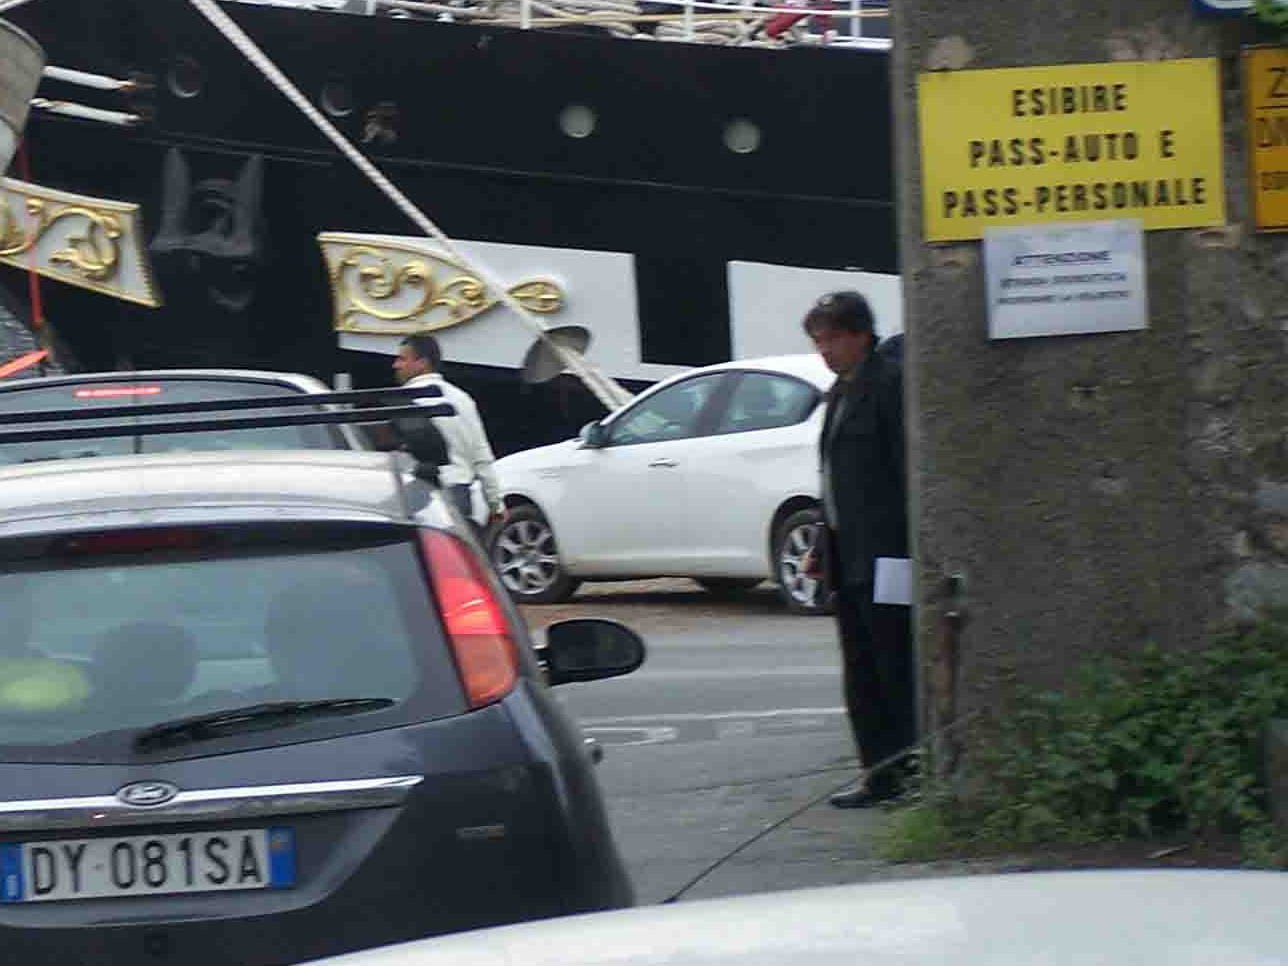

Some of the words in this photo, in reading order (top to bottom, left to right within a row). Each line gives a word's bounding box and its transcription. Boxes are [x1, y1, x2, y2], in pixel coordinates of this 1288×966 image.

[1012, 83, 1127, 117] ESIBIRE
[969, 131, 1139, 168] PASS-AUTO
[1159, 130, 1175, 159] E
[942, 177, 1206, 218] PASS-PERSONALE
[31, 843, 88, 896] DY
[111, 834, 263, 890] 081SA
